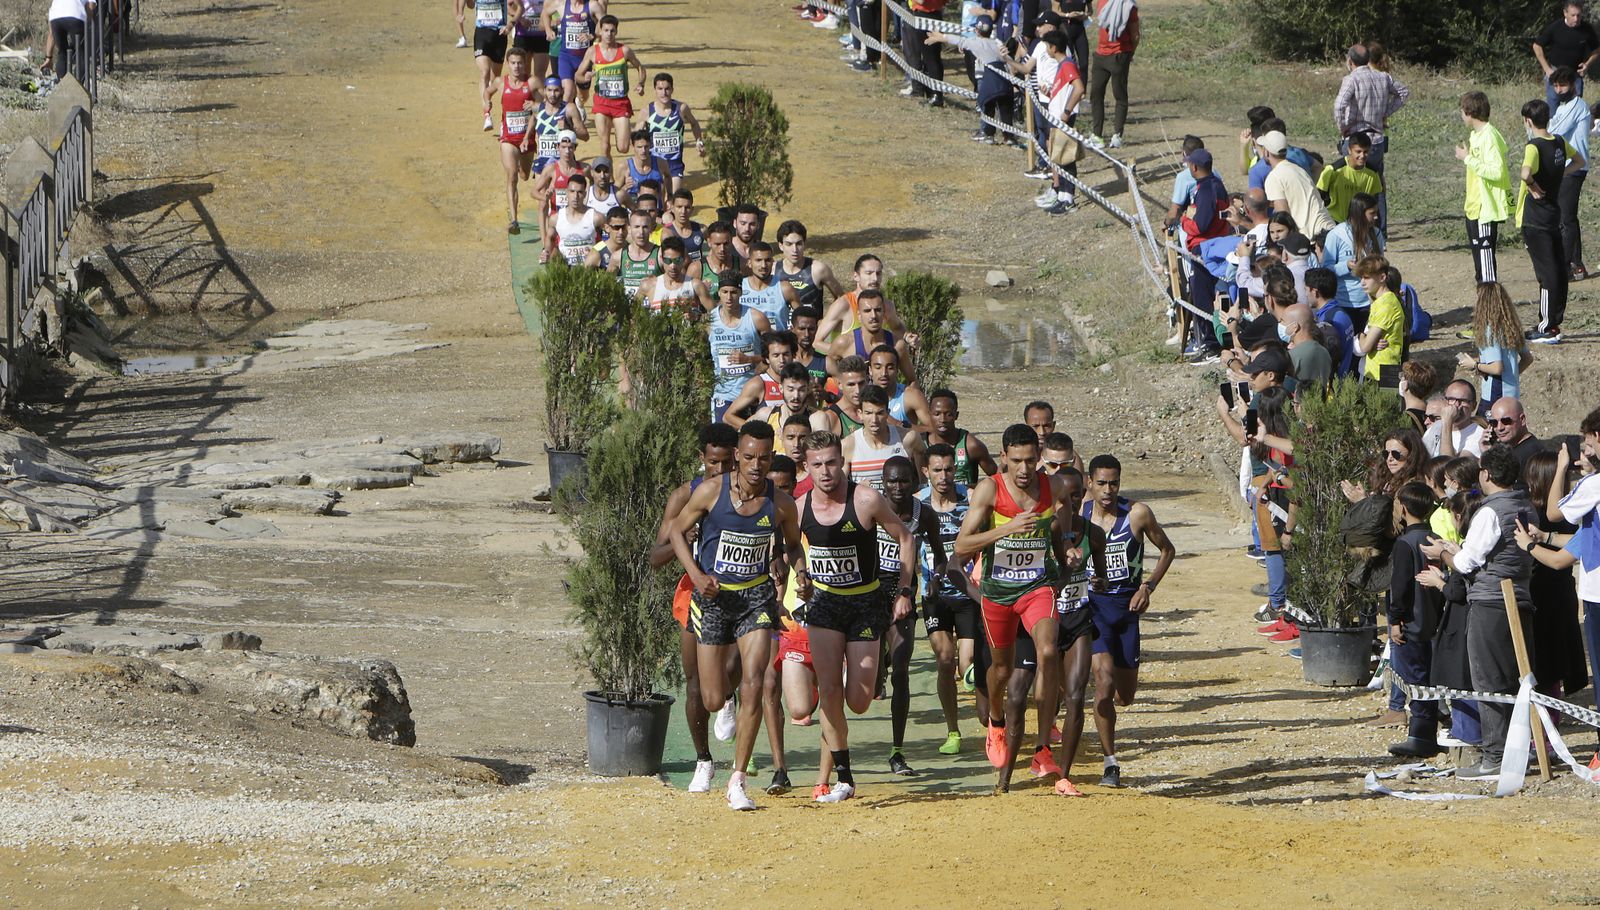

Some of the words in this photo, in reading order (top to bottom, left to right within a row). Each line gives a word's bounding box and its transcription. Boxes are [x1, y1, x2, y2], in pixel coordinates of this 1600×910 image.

[655, 137, 678, 147] MATEO
[740, 295, 767, 304] nerja
[715, 333, 742, 342] nerja
[1023, 541, 1031, 549] DE
[722, 545, 765, 564] WORKU
[1007, 553, 1034, 566] 109
[719, 562, 758, 574] Joma
[811, 558, 855, 574] MAYO
[998, 568, 1038, 580] Joma
[1057, 600, 1081, 610] oma
